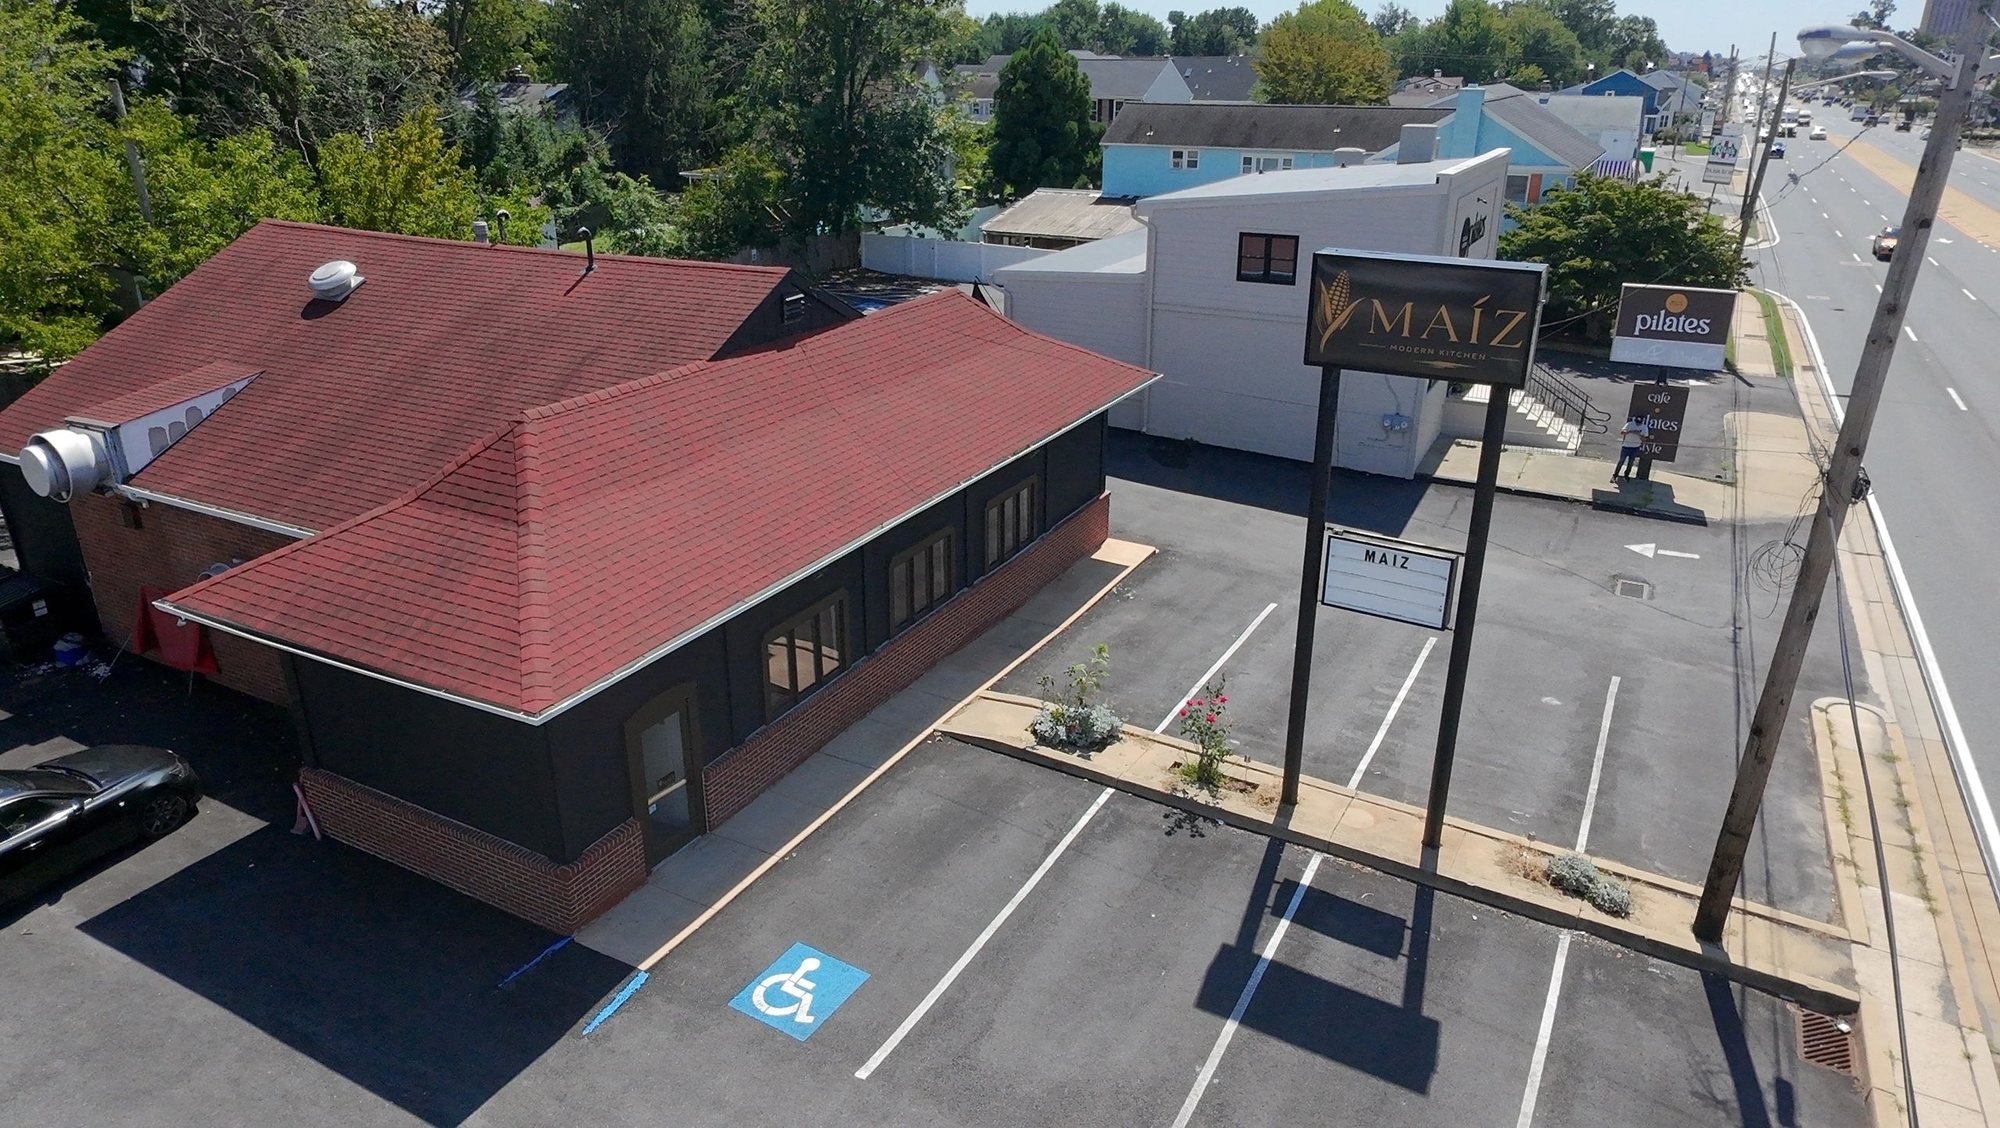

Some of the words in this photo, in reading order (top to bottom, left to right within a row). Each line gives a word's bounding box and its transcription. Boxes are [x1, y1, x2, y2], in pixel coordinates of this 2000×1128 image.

[1368, 294, 1528, 349] MAÍZ
[1633, 309, 1712, 336] pilates
[1389, 344, 1435, 356] MODERN
[1439, 349, 1488, 361] KITCHEN
[1639, 443, 1663, 454] tyle
[1364, 549, 1410, 569] MAIZ
